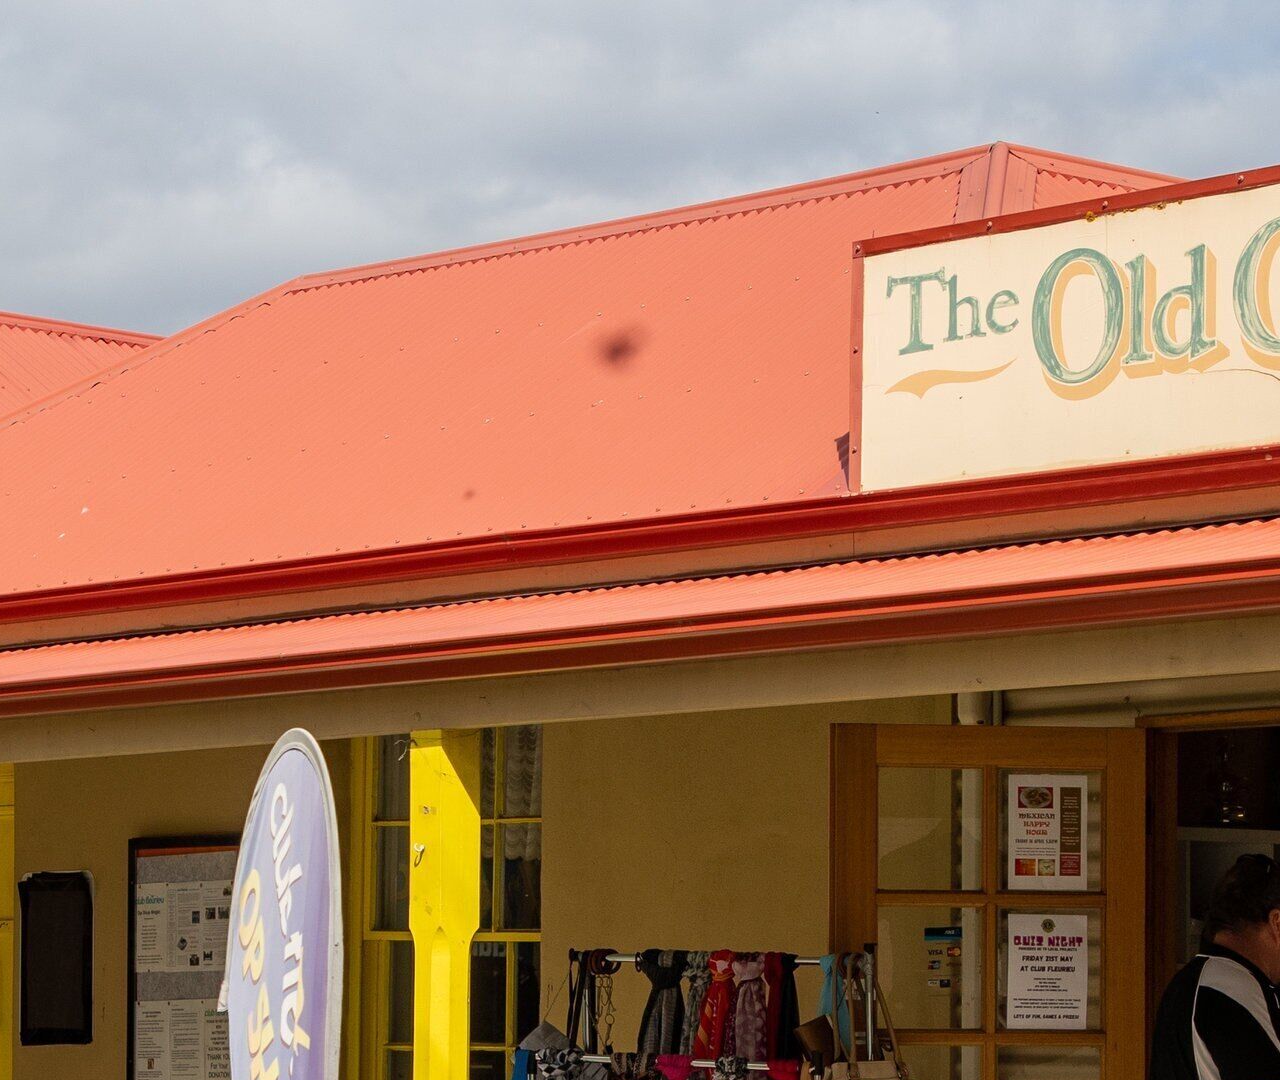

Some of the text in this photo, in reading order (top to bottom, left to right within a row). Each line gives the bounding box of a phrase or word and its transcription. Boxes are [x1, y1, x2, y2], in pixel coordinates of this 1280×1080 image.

[886, 266, 1020, 356] The
[1031, 243, 1220, 390] Old
[1014, 936, 1083, 947] QUIZ NIGHT
